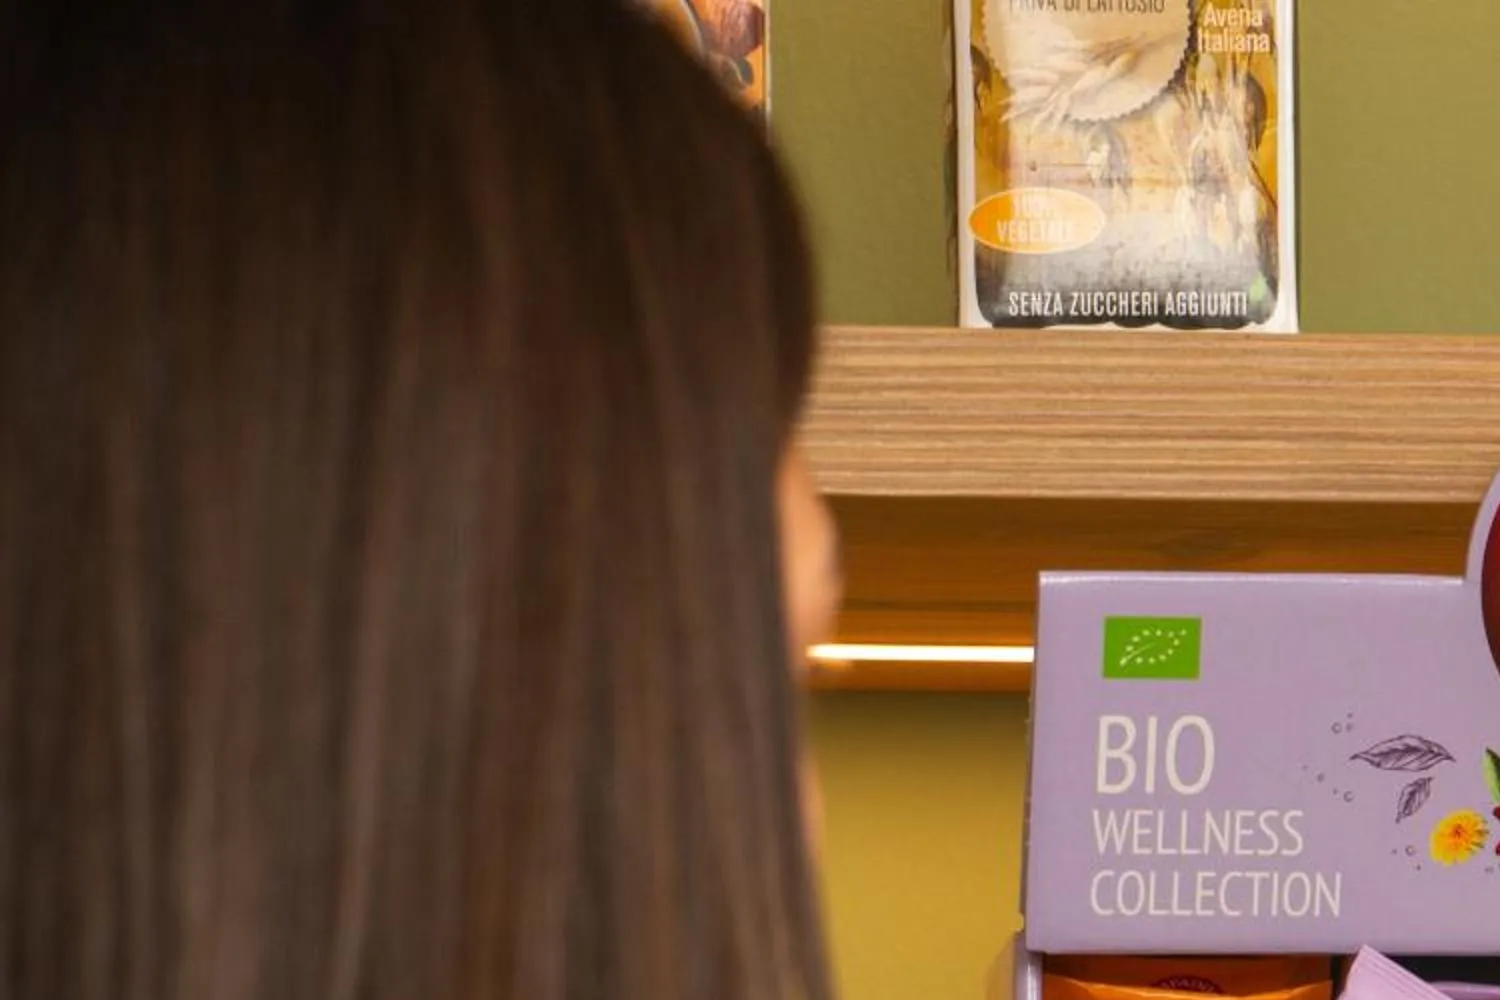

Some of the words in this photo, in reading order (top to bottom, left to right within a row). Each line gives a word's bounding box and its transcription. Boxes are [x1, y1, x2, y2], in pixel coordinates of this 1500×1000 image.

[1203, 6, 1263, 27] Avena
[1198, 27, 1270, 53] Italiana
[1007, 290, 1064, 317] SENZA
[1069, 290, 1159, 317] ZUCCHERI
[1164, 290, 1248, 318] AGGIUNTI
[1096, 714, 1216, 795] BIO
[1092, 809, 1305, 856] WELLNESS
[1090, 869, 1342, 919] COLLECTION
